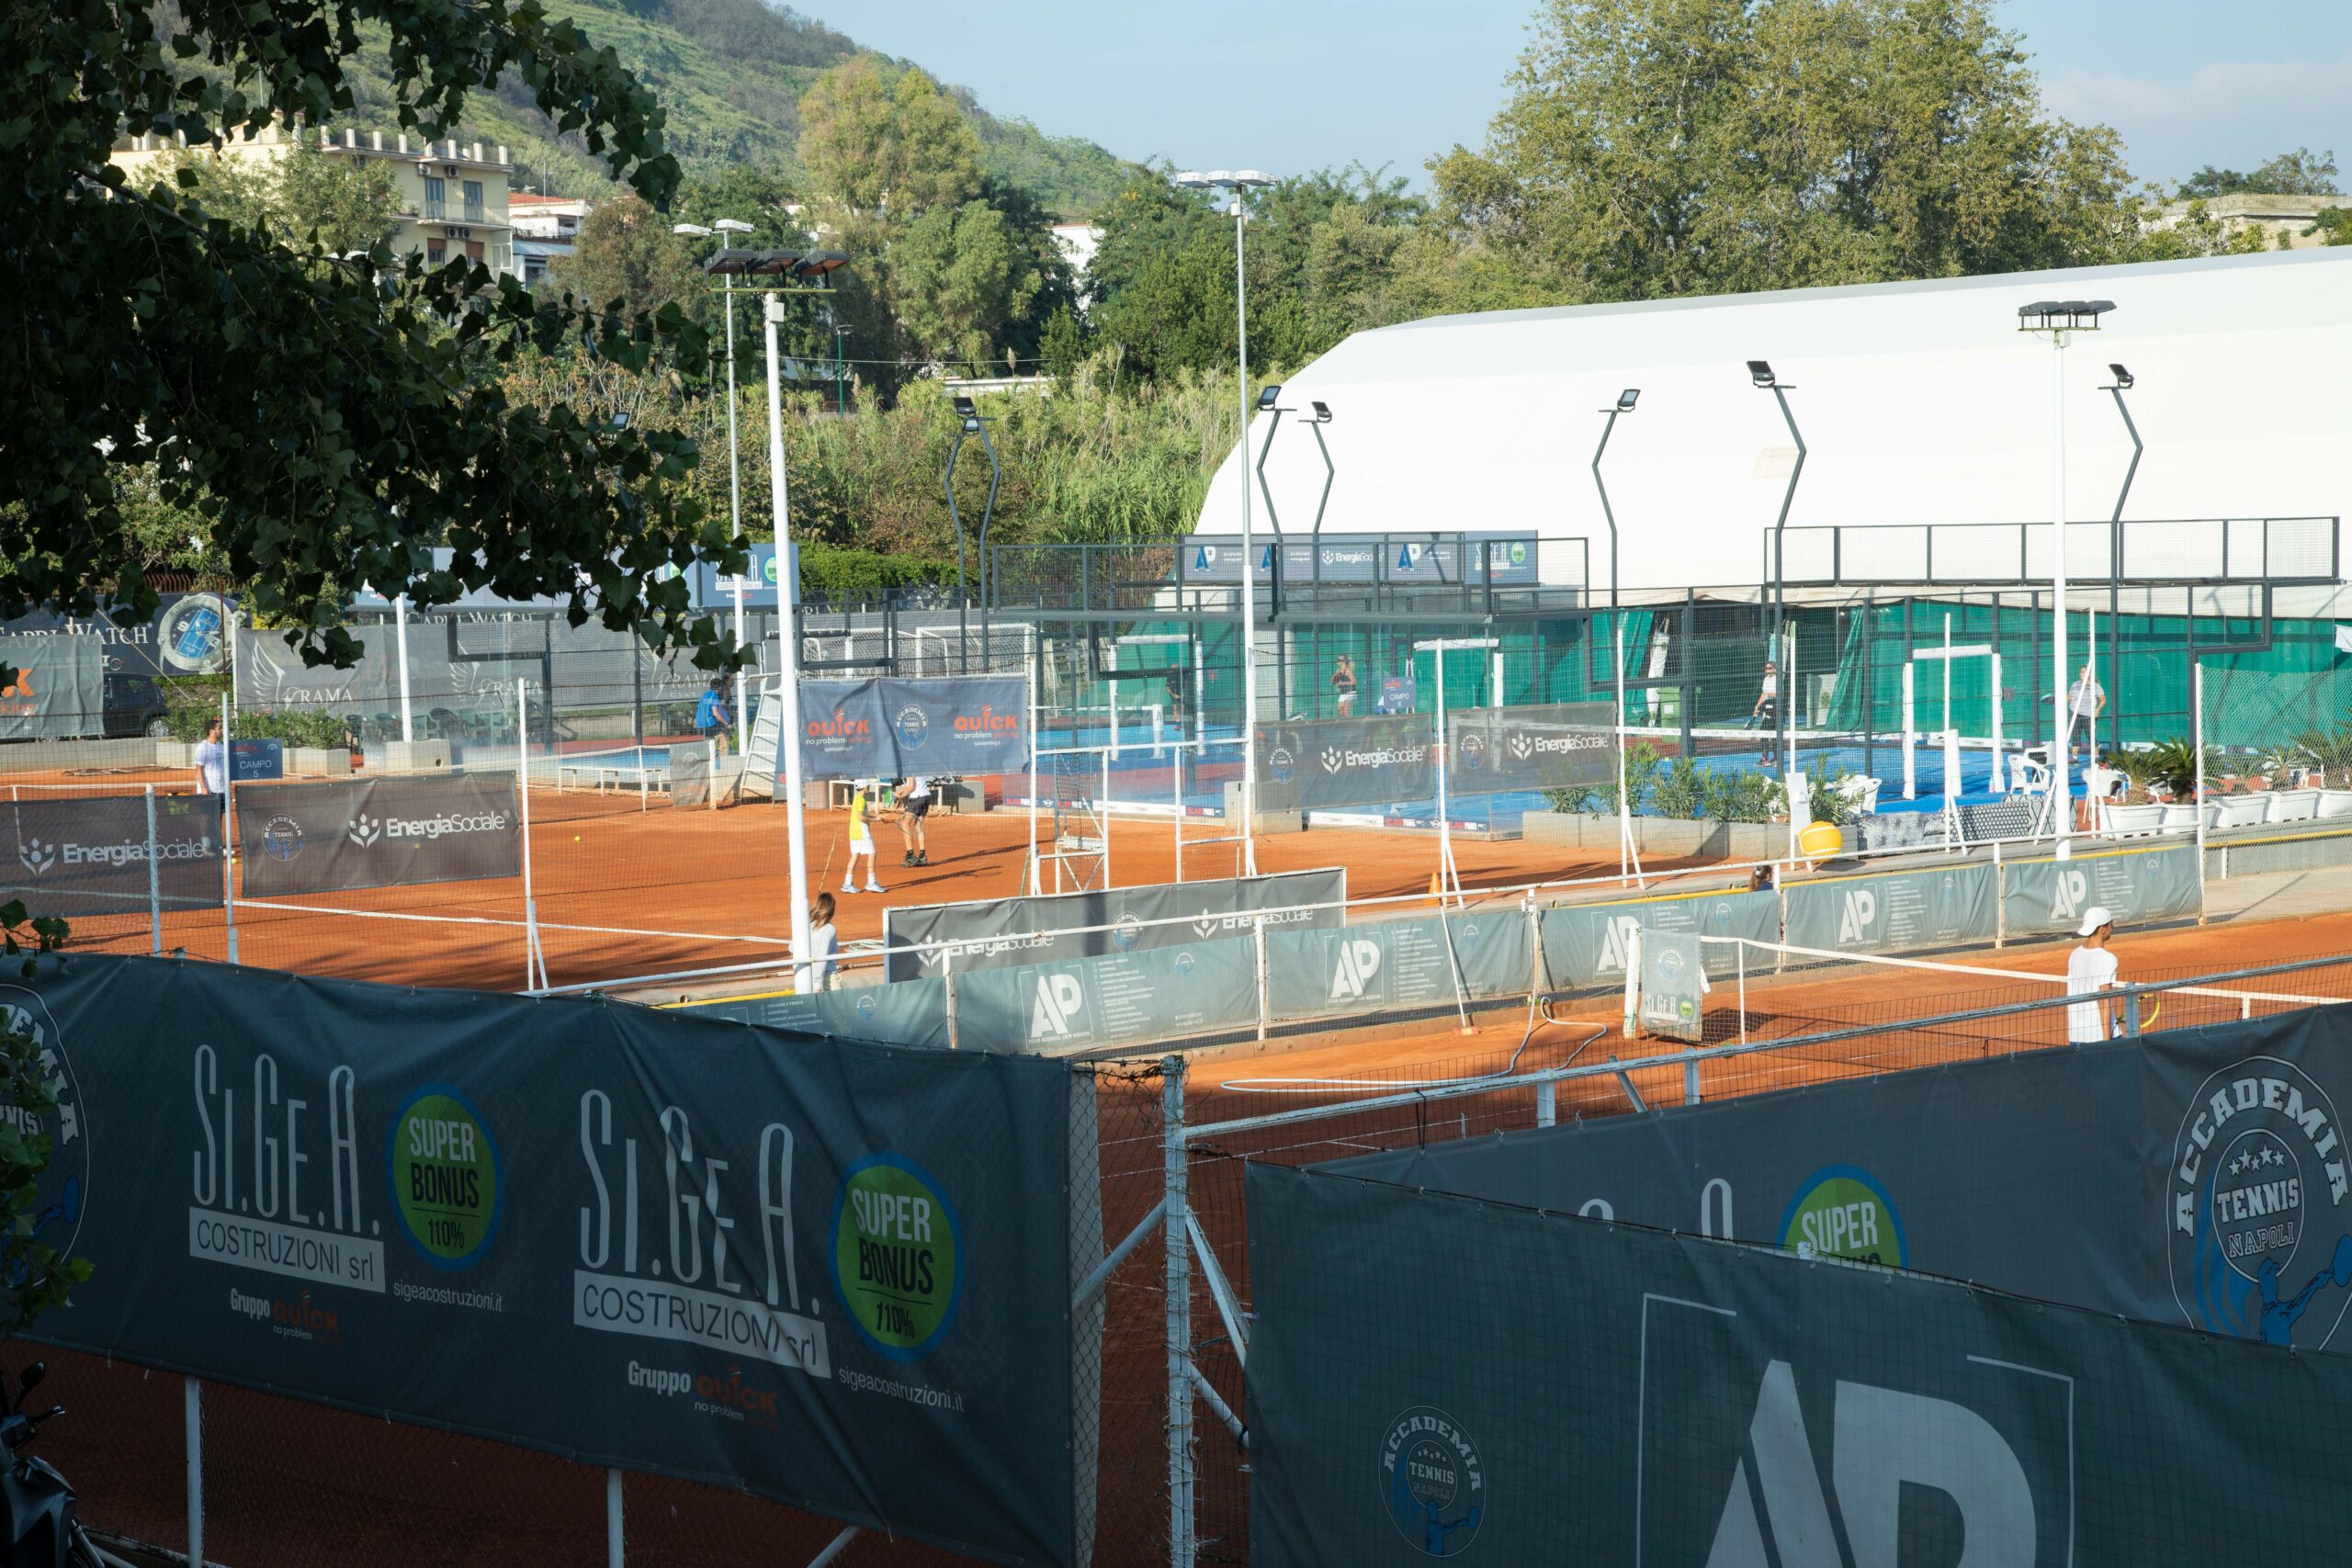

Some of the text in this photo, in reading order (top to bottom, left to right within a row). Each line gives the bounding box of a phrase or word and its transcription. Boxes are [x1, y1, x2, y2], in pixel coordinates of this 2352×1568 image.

[0, 623, 149, 649] APRI WATCH
[1389, 693, 1410, 701] CAMPO
[808, 710, 870, 738] QUICK
[954, 705, 1018, 733] QUICK
[964, 730, 992, 740] problem
[816, 737, 845, 746] problem
[1345, 747, 1424, 769] EnergiaSociale
[1534, 732, 1609, 754] EnergiaSociale
[239, 759, 272, 770] CAMPO
[253, 770, 259, 778] 5
[264, 817, 302, 839] ACCADEMIA
[2050, 870, 2087, 919] AP
[1838, 889, 1876, 943] AP
[1329, 939, 1381, 998] AP
[1030, 974, 1083, 1038] AP
[409, 1115, 476, 1164] SUPER
[2176, 1077, 2349, 1238] ACCADEMIA
[410, 1161, 480, 1210] BONUS
[2216, 1178, 2300, 1224] TENNIS
[426, 1217, 466, 1250] 110%
[851, 1187, 932, 1243] SUPER
[1801, 1201, 1880, 1255] SUPER
[196, 1218, 375, 1283] COSTRUZIONI srl
[2227, 1221, 2295, 1259] NAPOLI
[857, 1235, 935, 1295] BONUS
[230, 1288, 271, 1321] Gruppo
[392, 1280, 503, 1313] sigeacostruzioni.it
[582, 1283, 782, 1348] COSTRUZIONI
[283, 1325, 313, 1341] problem
[876, 1301, 916, 1339] 110%
[628, 1359, 779, 1416] Gruppo QUICK
[838, 1365, 965, 1412] sigeacostruzioni.it
[694, 1401, 744, 1422] no problem
[1384, 1416, 1482, 1492] ACCADEMIA
[1408, 1461, 1455, 1485] TENNIS
[1704, 1359, 2038, 1568] AP
